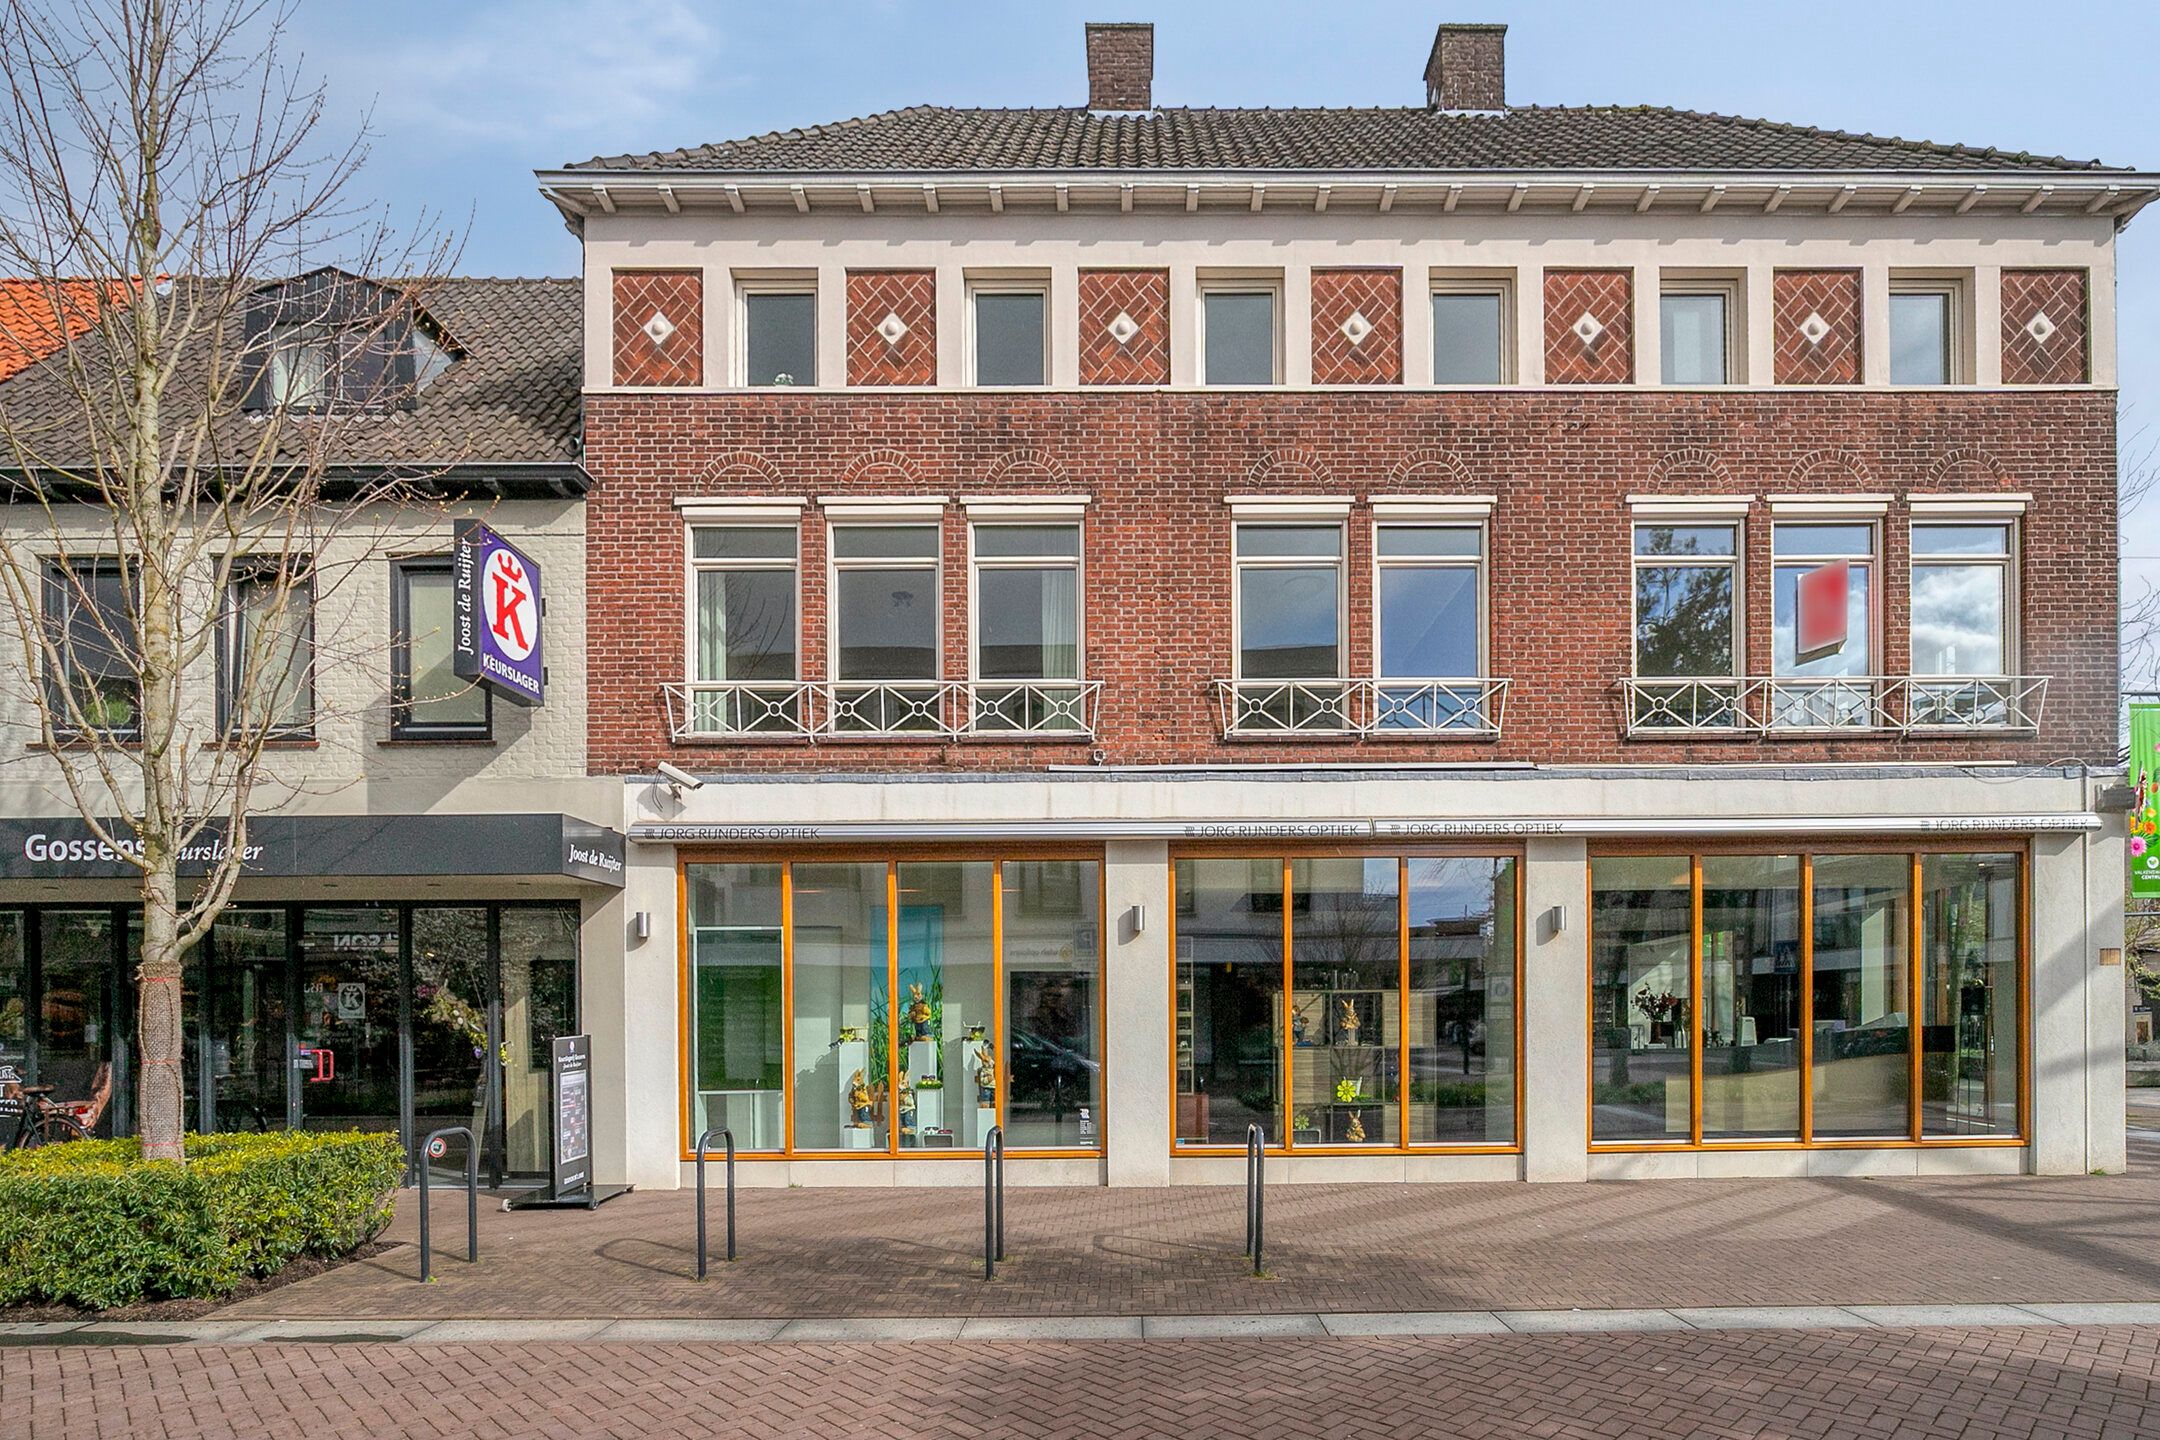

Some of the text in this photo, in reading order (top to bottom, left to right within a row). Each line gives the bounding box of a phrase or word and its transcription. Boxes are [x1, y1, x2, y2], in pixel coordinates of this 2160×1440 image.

[457, 537, 475, 656] Joost de Ruijter
[491, 571, 529, 652] K
[482, 652, 541, 695] KEURSLAGER
[658, 828, 696, 840] JORG
[768, 827, 821, 839] OPTIEK
[1199, 825, 1236, 837] JORG
[1308, 824, 1359, 836] OPTIEK
[1403, 823, 1441, 836] JORG
[1513, 822, 1565, 835] OPTIEK
[568, 843, 588, 863] Joost
[589, 849, 599, 866] de
